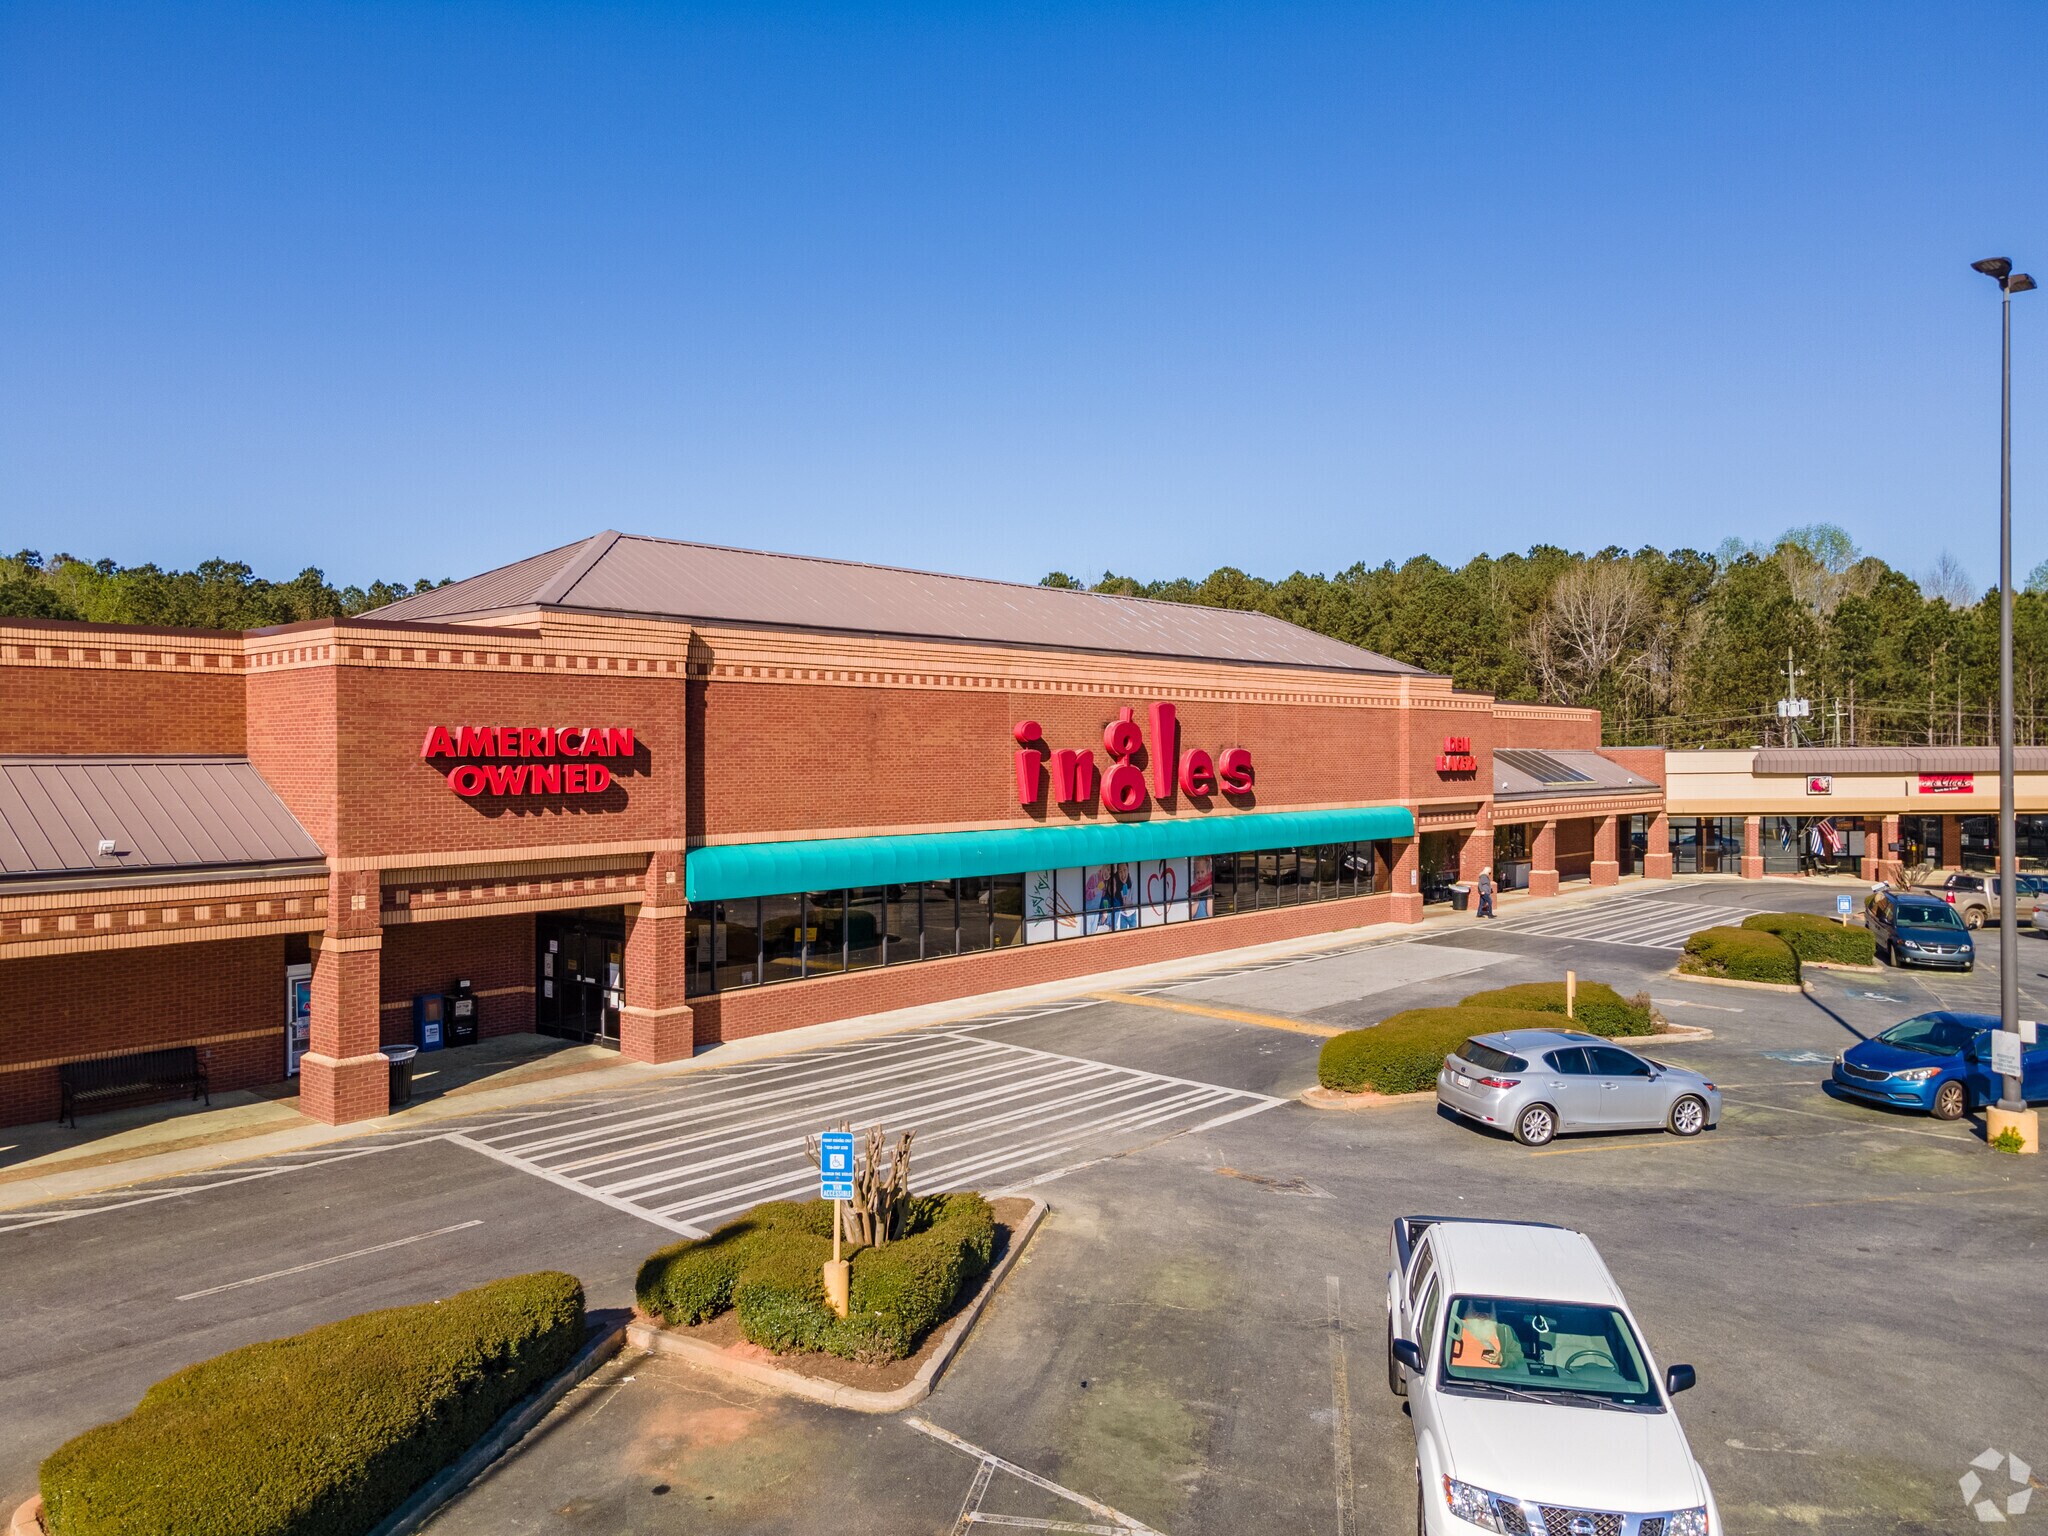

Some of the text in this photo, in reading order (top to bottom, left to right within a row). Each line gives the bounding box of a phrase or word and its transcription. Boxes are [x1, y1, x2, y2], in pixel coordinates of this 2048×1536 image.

[420, 726, 635, 758] AMERICAN
[1013, 702, 1253, 813] ingles
[447, 764, 611, 796] OWNED
